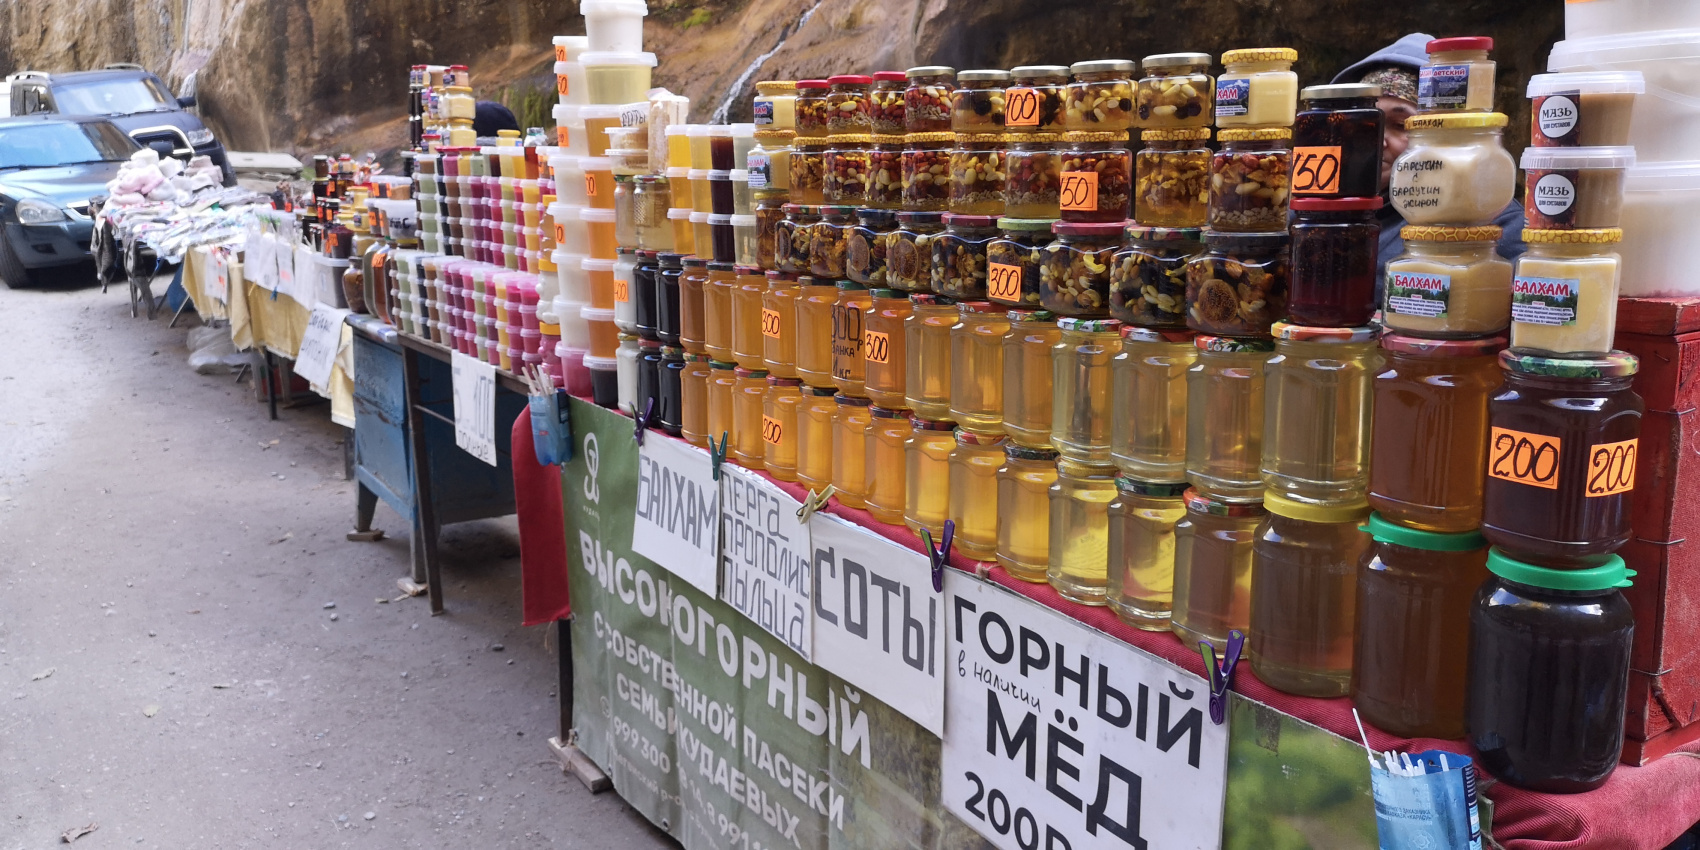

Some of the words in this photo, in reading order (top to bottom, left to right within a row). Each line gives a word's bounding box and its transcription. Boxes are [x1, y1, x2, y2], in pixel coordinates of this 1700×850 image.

[1006, 92, 1037, 125] 100
[1542, 107, 1573, 119] МАЗЬ
[1550, 121, 1571, 129] СУСТАВОВ
[1292, 153, 1339, 191] 150
[1538, 186, 1570, 196] МАЗЬ
[990, 267, 1020, 297] 300
[1394, 275, 1442, 291] БАЛХАМ
[1514, 280, 1569, 297] БАЛХАМ
[762, 310, 780, 335] 300
[866, 333, 889, 362] 300
[763, 417, 782, 444] 200
[1493, 433, 1559, 482] 200
[1588, 443, 1636, 494] 200
[637, 453, 717, 557] БАЛХАМ
[722, 512, 810, 600] ПРОПОЛИС
[815, 546, 936, 678] СОТЫ
[579, 529, 871, 770] ВЫСОКОГОРНЫЙ
[954, 595, 1203, 769] ГОРНЫЙ
[958, 650, 966, 677] в
[973, 661, 1042, 713] наличии
[594, 610, 604, 638] С
[743, 724, 845, 831] ПАСЕКИ
[641, 735, 671, 774] 300
[986, 687, 1148, 850] МЁД
[679, 720, 802, 850] КУДАЕВЫХ
